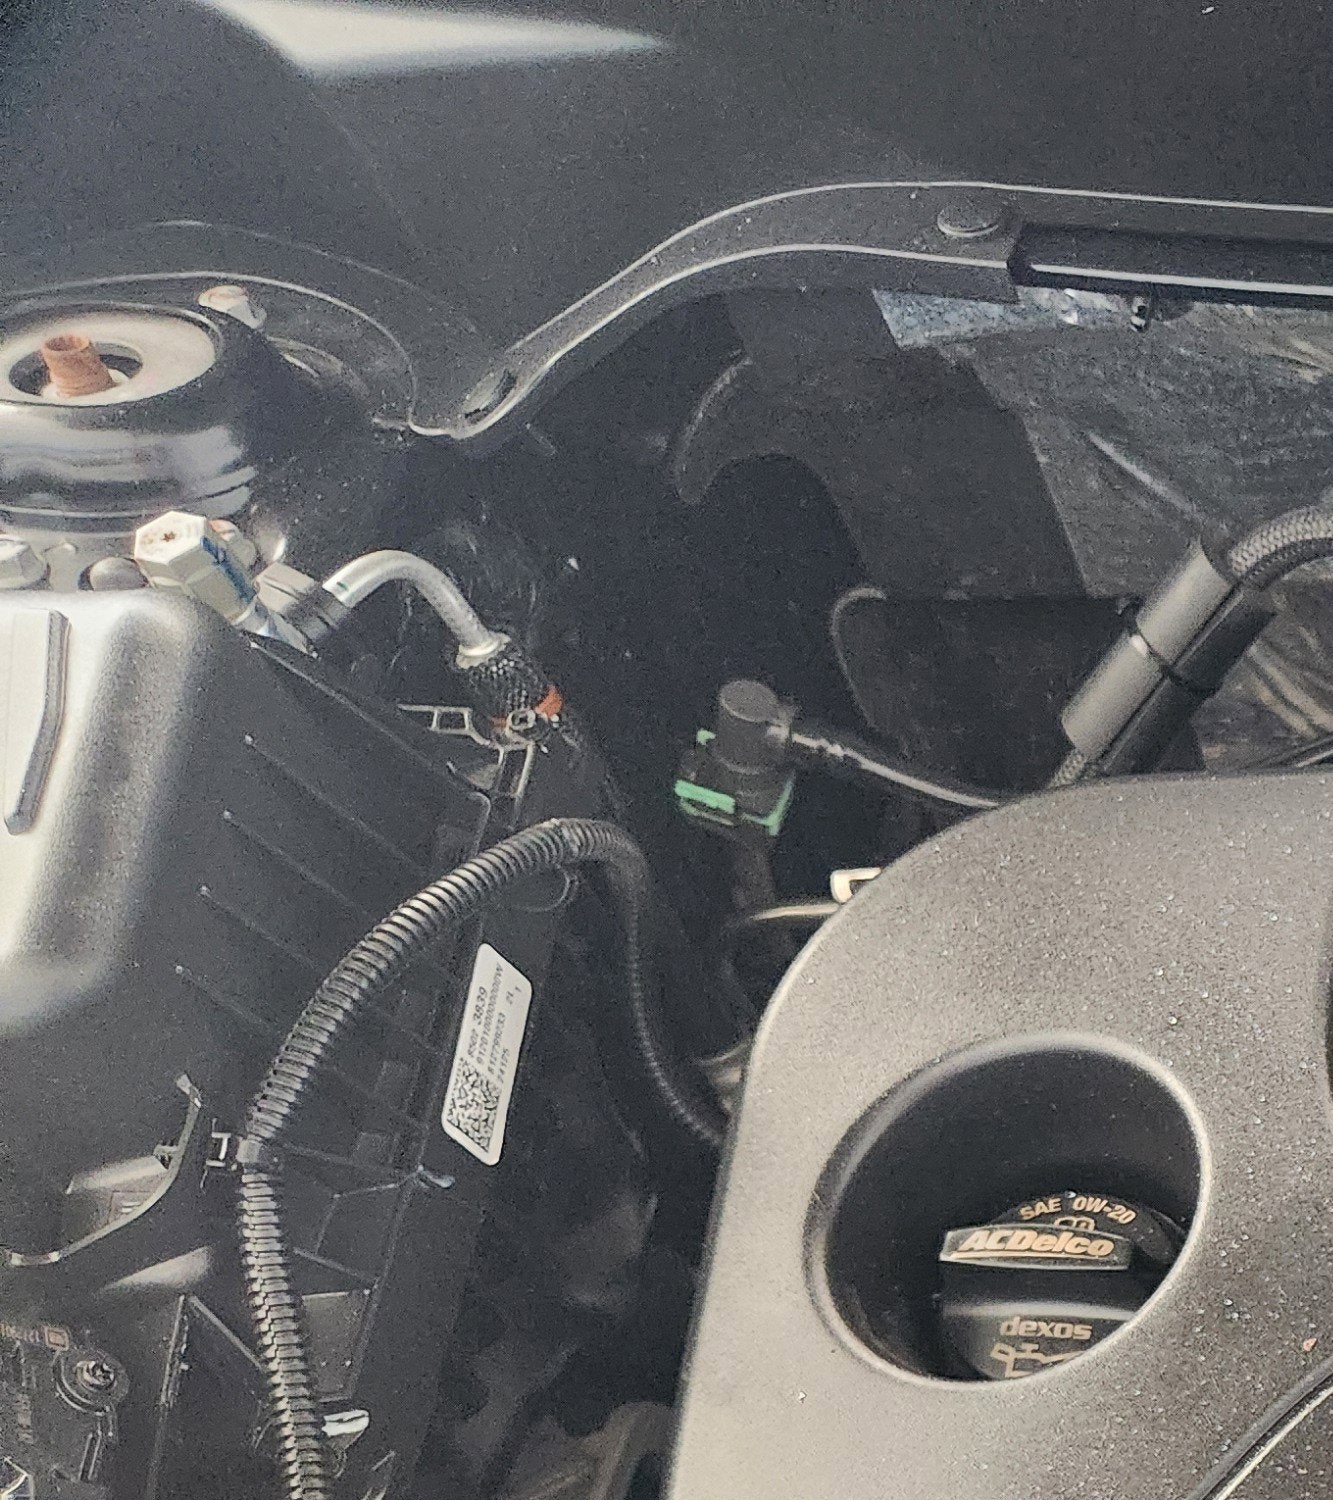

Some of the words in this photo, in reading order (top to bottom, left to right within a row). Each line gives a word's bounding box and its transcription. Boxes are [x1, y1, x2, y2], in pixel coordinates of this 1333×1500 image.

[1019, 1197, 1062, 1220] SAE
[1071, 1196, 1137, 1225] 0W-20
[957, 1229, 1116, 1257] ACDelco
[1001, 1316, 1093, 1340] dexos
